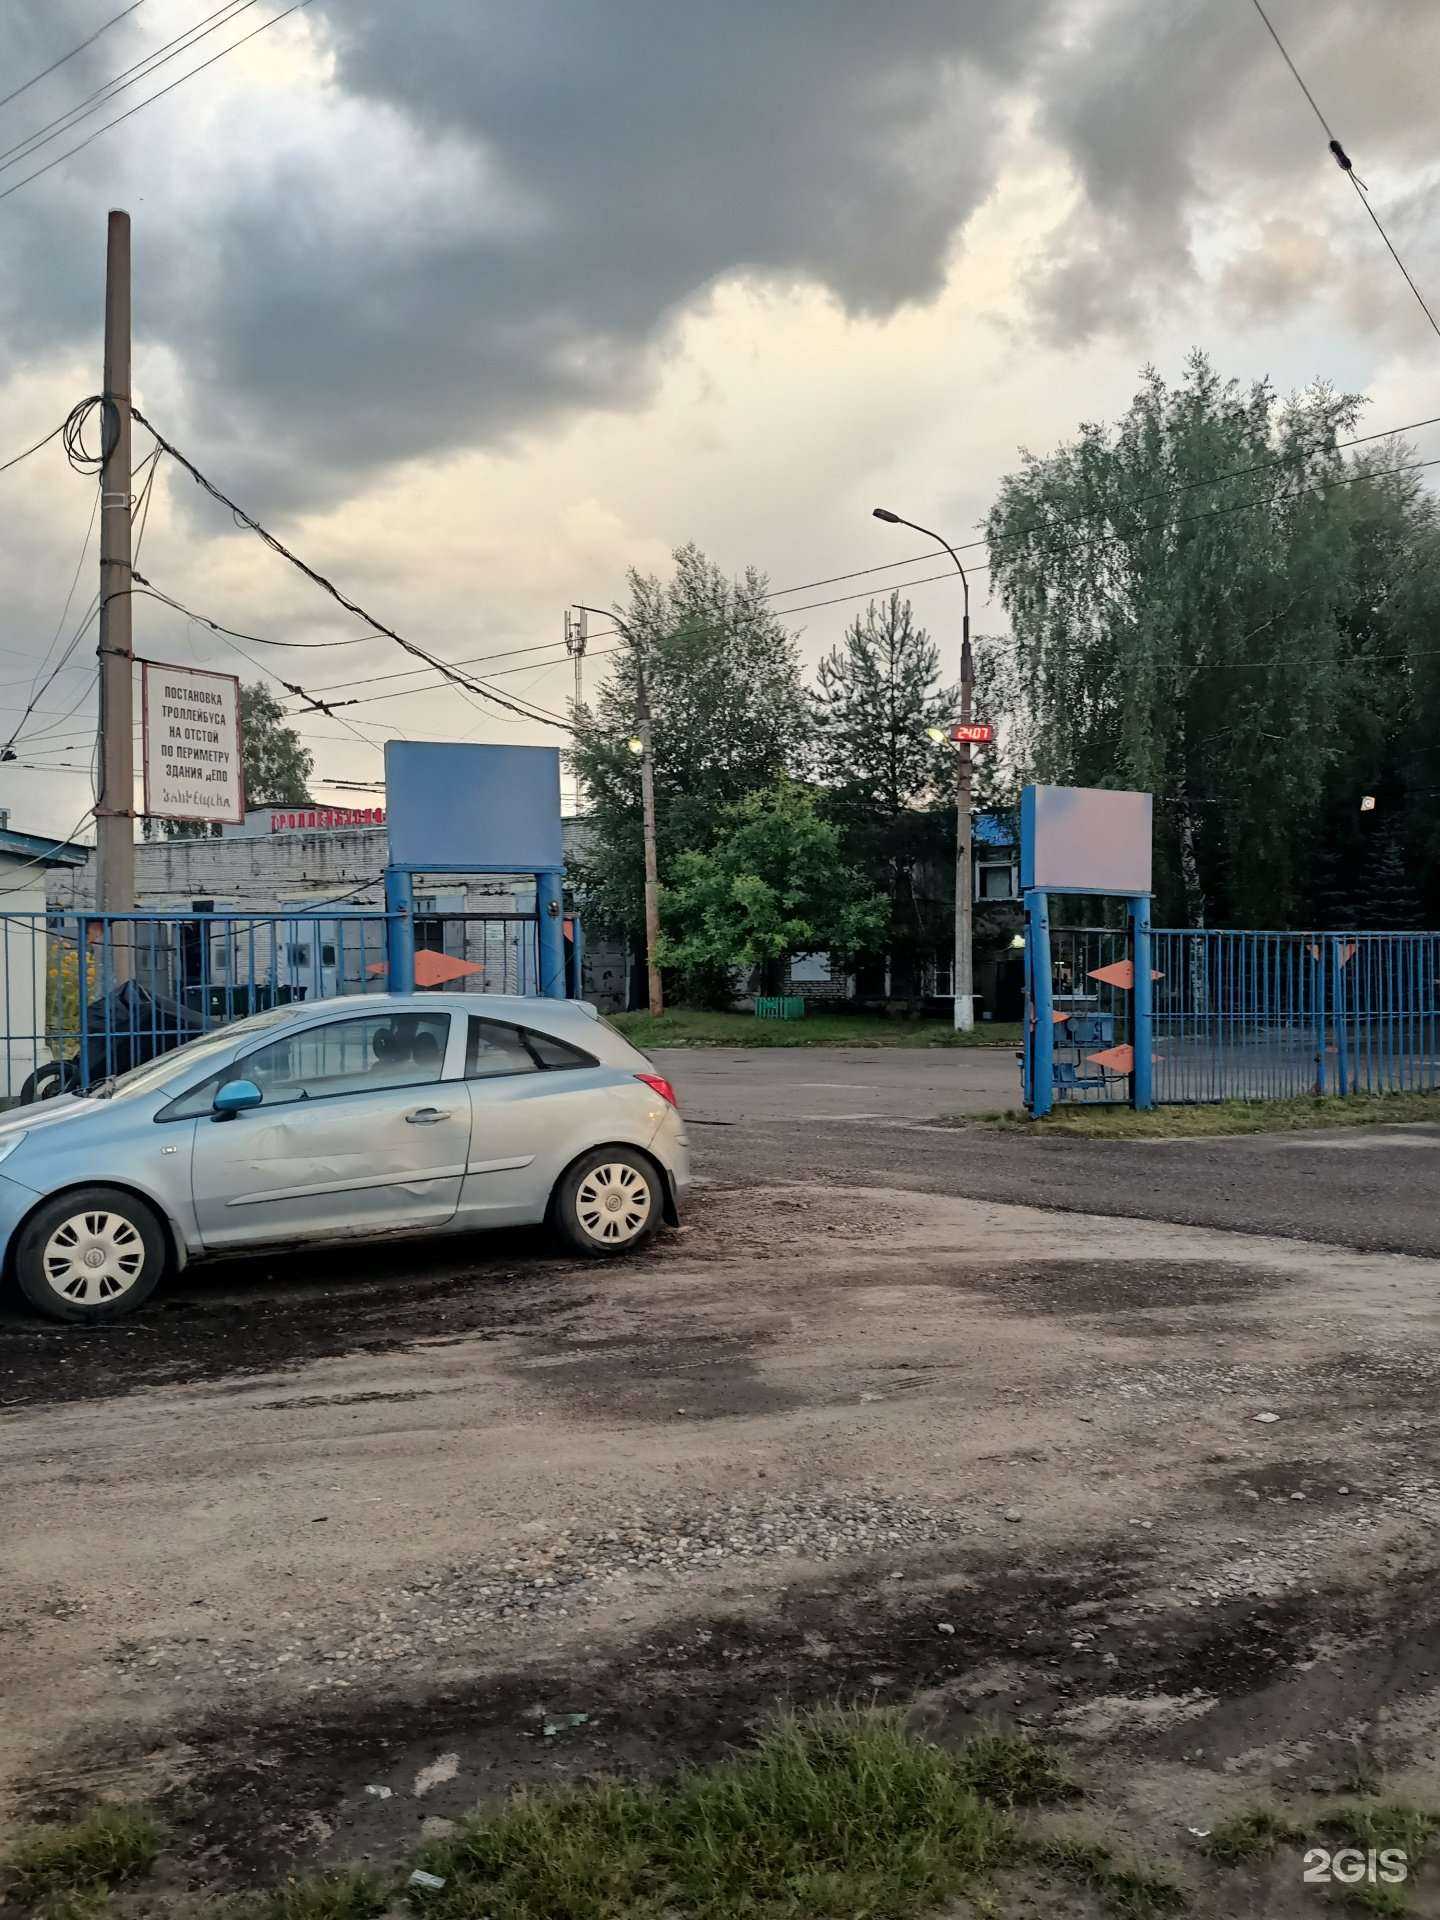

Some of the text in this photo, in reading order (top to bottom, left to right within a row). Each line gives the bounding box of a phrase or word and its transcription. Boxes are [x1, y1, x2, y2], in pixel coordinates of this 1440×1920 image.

[164, 685, 223, 707] ПОСТАНОВКА
[161, 705, 226, 726] ТРОЛЛЕЙБУСА
[169, 726, 219, 744] НА ОТСТОЙ
[161, 745, 230, 764] ПО ПЕРИМЕТРУ
[166, 764, 203, 780] ЗДАНИЯ
